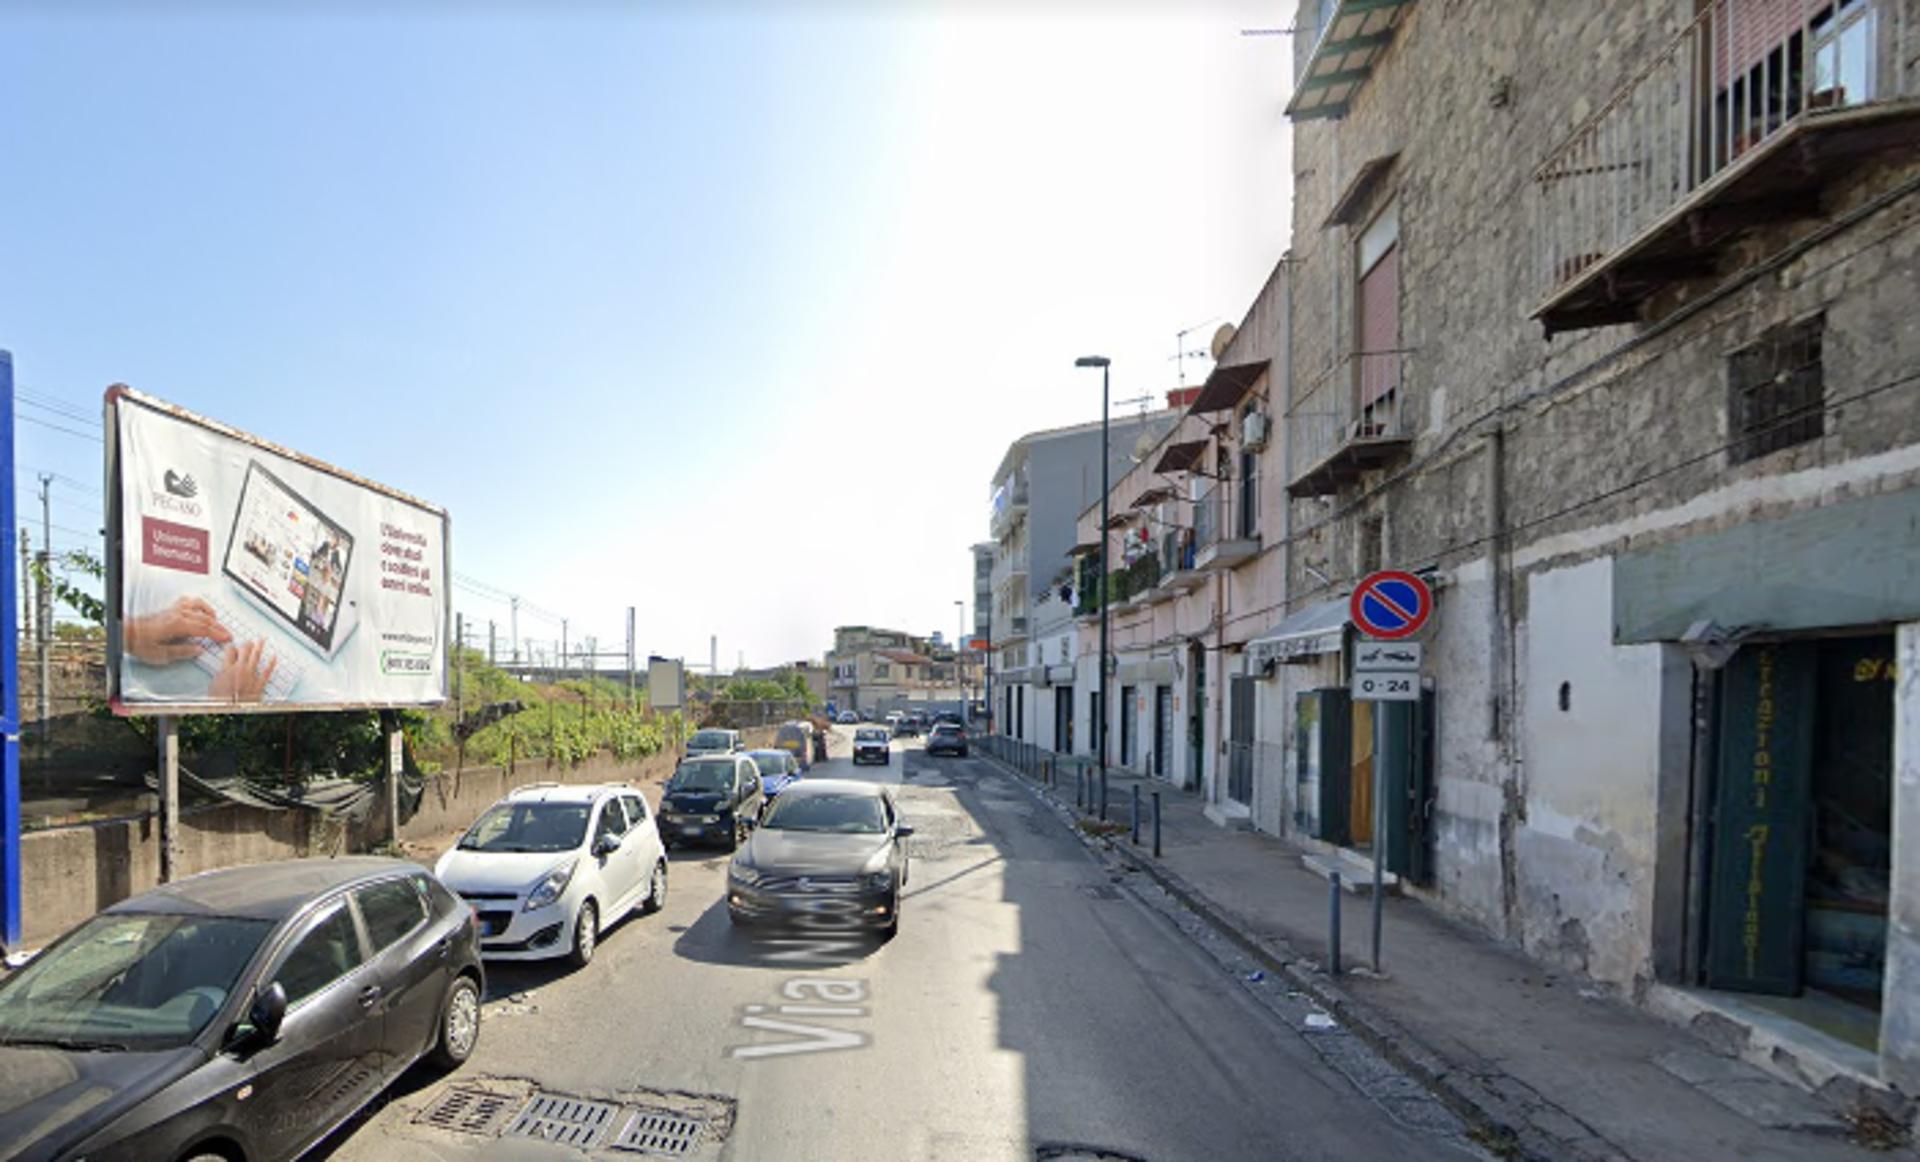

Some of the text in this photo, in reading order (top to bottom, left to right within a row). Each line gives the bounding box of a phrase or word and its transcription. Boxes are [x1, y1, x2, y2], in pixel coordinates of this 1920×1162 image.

[152, 491, 202, 517] PEGASO
[1361, 680, 1375, 692] 0
[1387, 680, 1410, 692] 24
